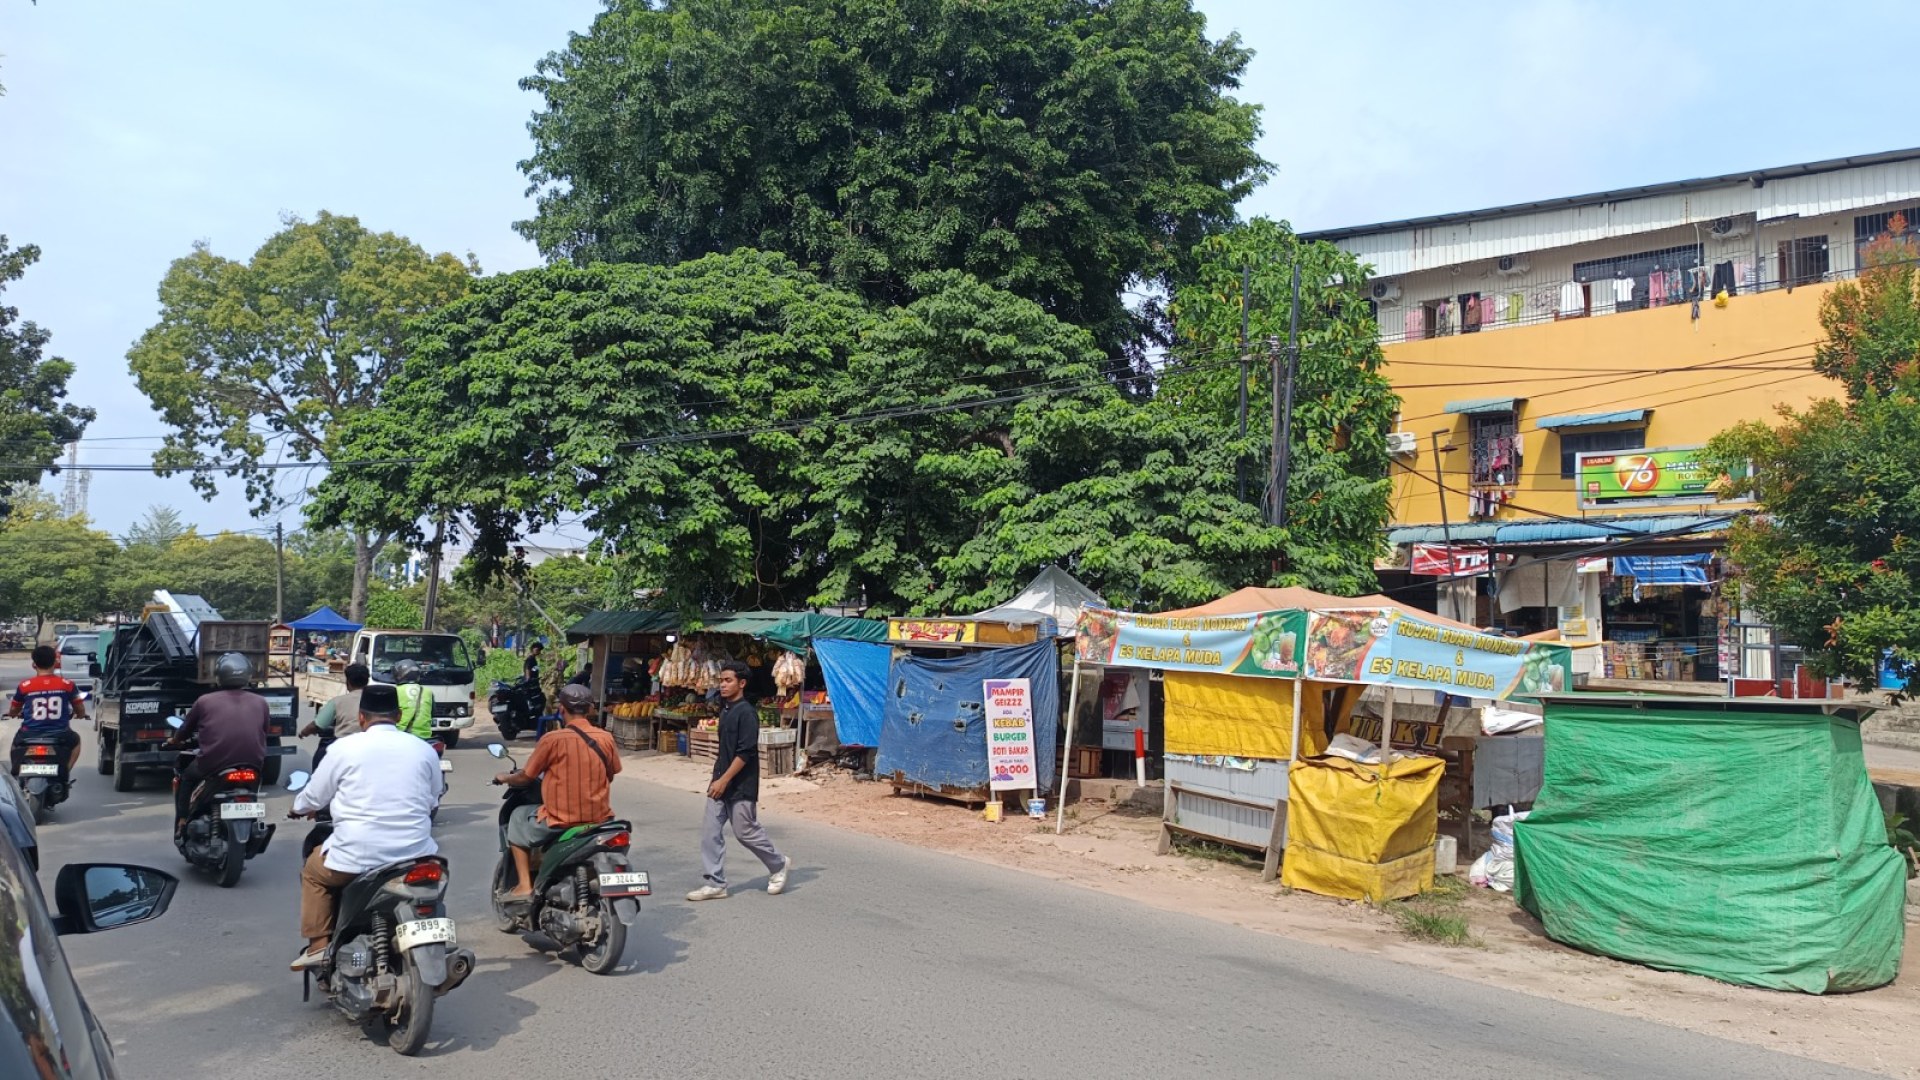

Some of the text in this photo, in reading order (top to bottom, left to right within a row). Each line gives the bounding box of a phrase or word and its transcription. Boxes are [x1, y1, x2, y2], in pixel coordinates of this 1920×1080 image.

[1182, 632, 1191, 646] &
[1397, 620, 1440, 643] RUJAK
[1440, 629, 1473, 648] BUAH
[1119, 644, 1222, 666] ES KELAPA MUDA
[1455, 650, 1464, 666] &
[1369, 657, 1495, 691] ES KELAPA MUDA
[991, 688, 1024, 696] MAMPIR
[32, 696, 62, 721] 69
[993, 718, 1026, 728] KEBAB
[993, 732, 1027, 742] BURGER
[992, 746, 1029, 756] ROTI BAKAR
[601, 875, 611, 885] BP
[397, 924, 408, 938] BP
[414, 919, 440, 932] 3899
